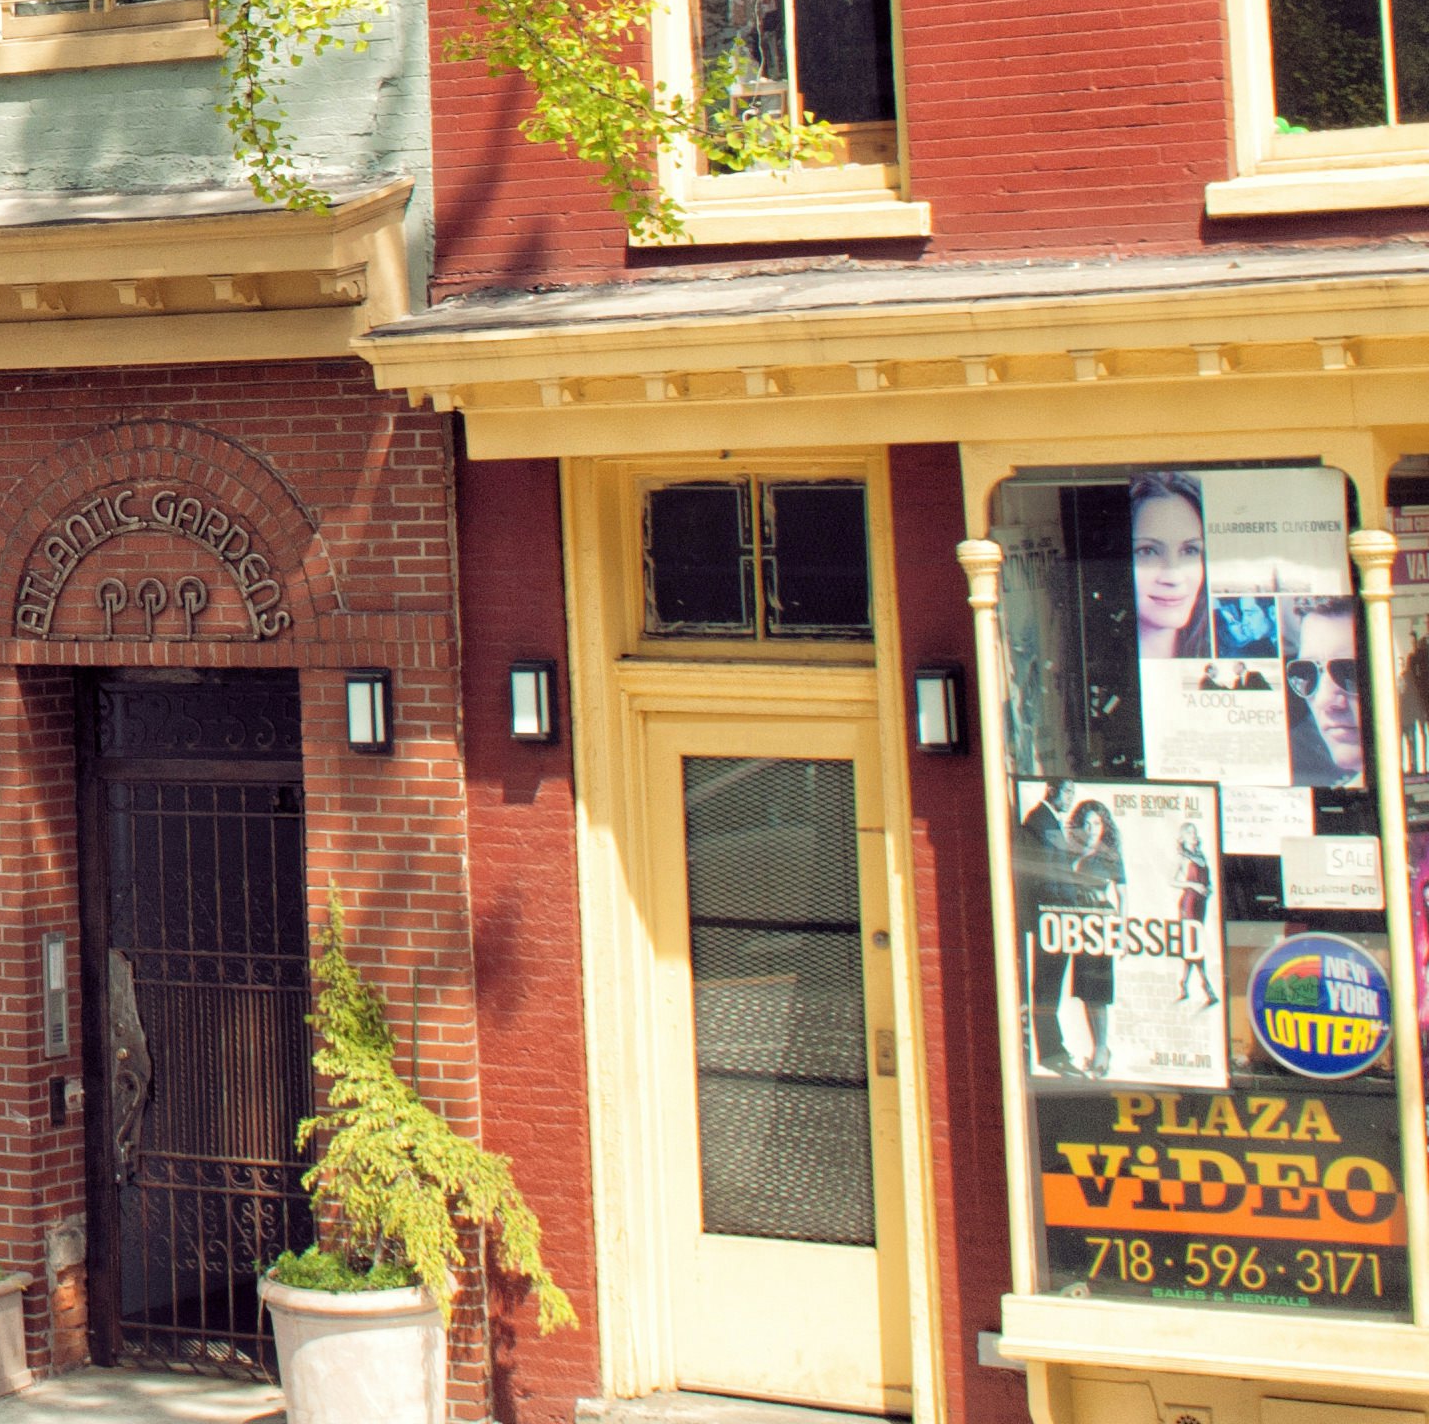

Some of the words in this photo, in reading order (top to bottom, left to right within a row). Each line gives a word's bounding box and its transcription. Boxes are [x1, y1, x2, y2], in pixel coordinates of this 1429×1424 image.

[16, 489, 140, 634] ATLANTIC
[151, 490, 292, 637] GARDENS
[1332, 848, 1374, 869] SALE
[1038, 911, 1206, 960] OBSESSED
[1324, 955, 1370, 986] NEW
[1325, 979, 1380, 1016] YORK
[1264, 1008, 1384, 1055] LOTTERY
[1110, 1091, 1341, 1143] PLAZA
[1152, 1288, 1206, 1302] SALES
[1213, 1292, 1225, 1303] &
[1233, 1292, 1310, 1308] RENTALS
